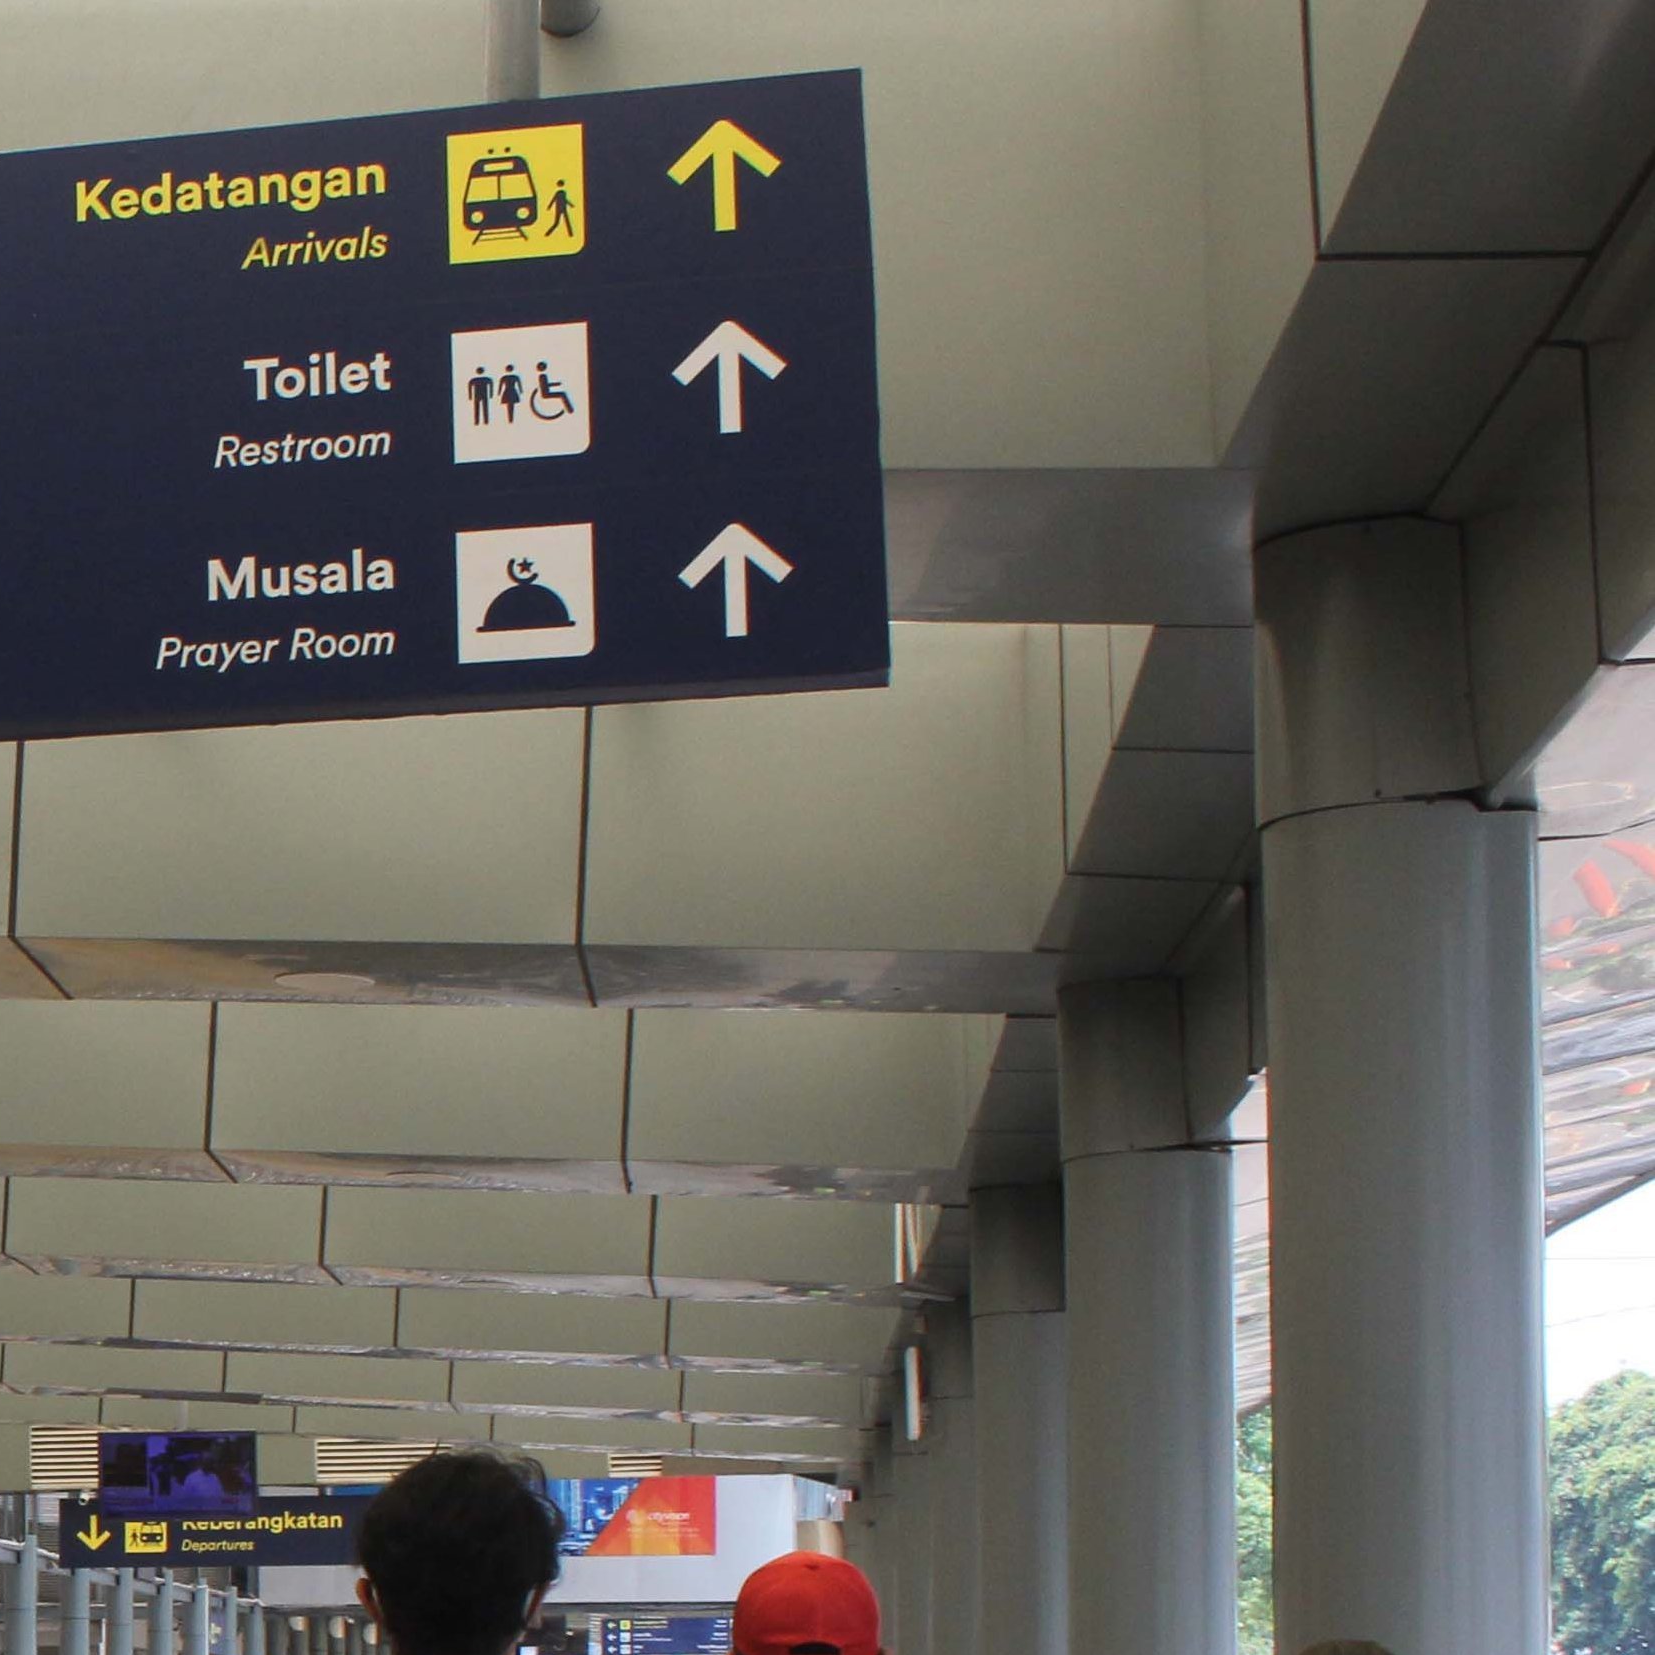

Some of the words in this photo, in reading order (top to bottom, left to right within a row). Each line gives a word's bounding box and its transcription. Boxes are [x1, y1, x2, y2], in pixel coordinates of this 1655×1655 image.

[76, 162, 386, 222] Kedatangan
[241, 225, 388, 270] Arrivals
[243, 351, 392, 401] Toilet
[214, 430, 391, 469] Restroom
[207, 548, 394, 602] Musala
[156, 634, 280, 673] Prayer
[289, 626, 396, 661] Room
[181, 1539, 256, 1553] Departures
